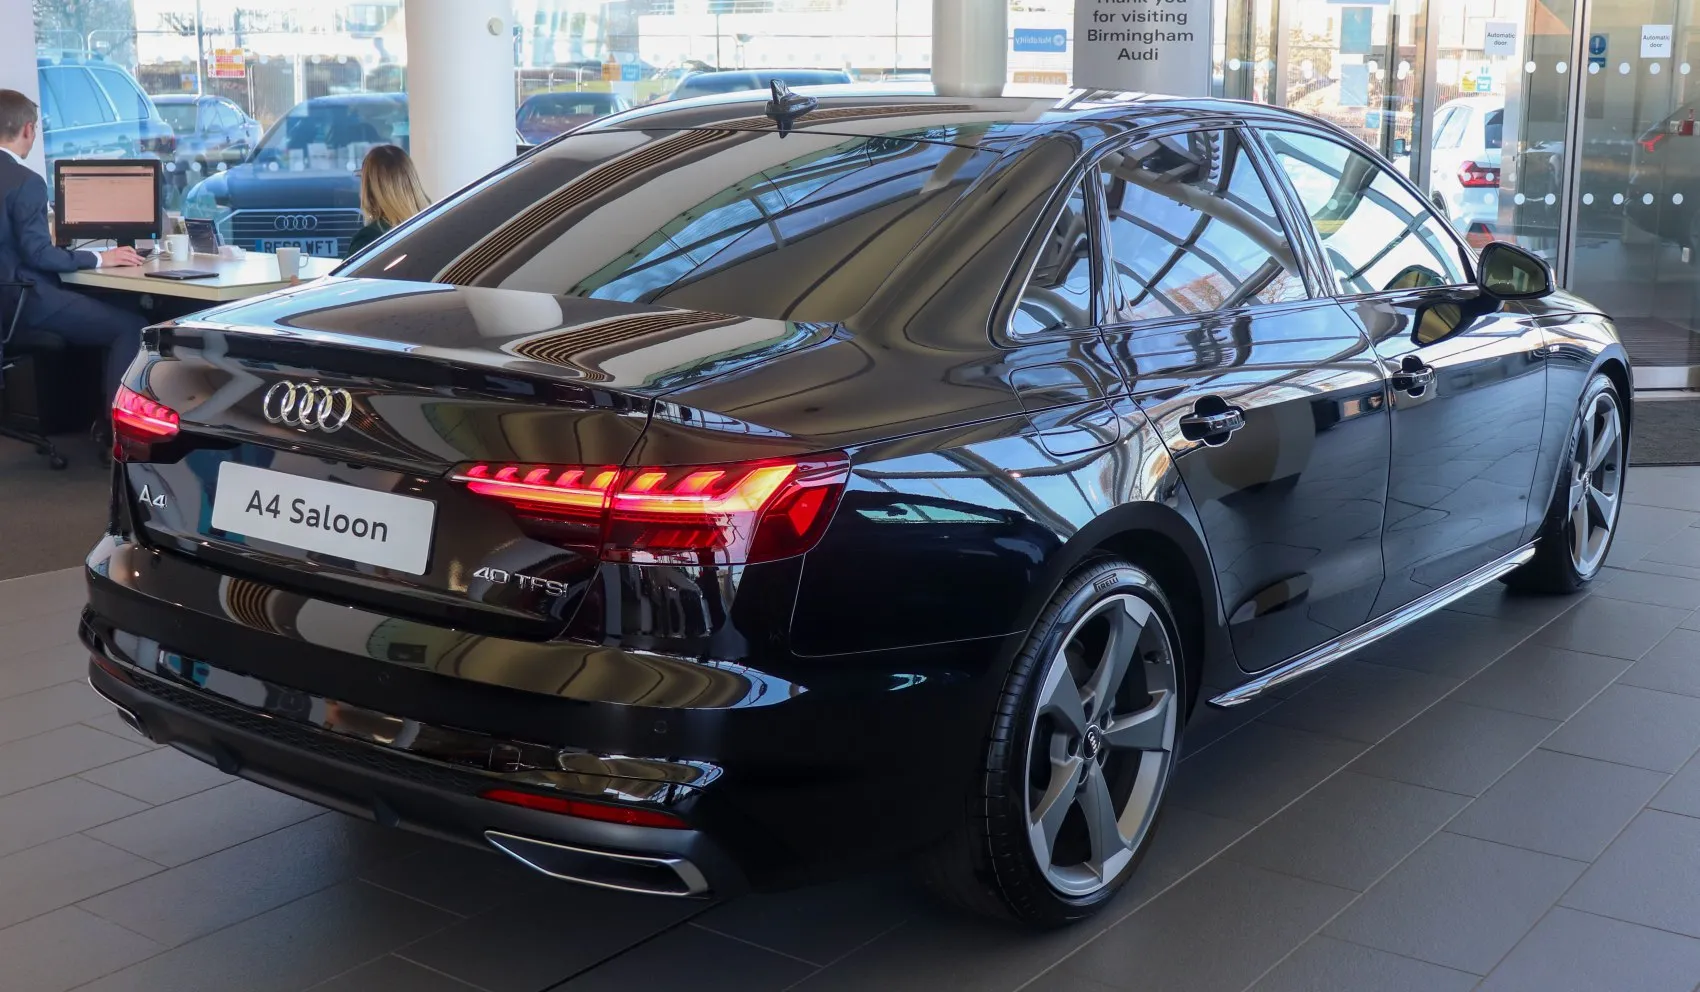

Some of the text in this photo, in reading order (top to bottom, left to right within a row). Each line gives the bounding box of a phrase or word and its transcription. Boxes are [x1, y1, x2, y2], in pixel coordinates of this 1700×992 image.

[1093, 9, 1188, 26] for visiting
[1087, 29, 1194, 45] Birmingham
[1117, 47, 1159, 61] Audi
[305, 240, 334, 255] WFT
[139, 484, 168, 509] A4
[245, 489, 388, 542] A4 Saloon
[473, 566, 511, 584] 40
[1093, 573, 1119, 592] PIRELLI
